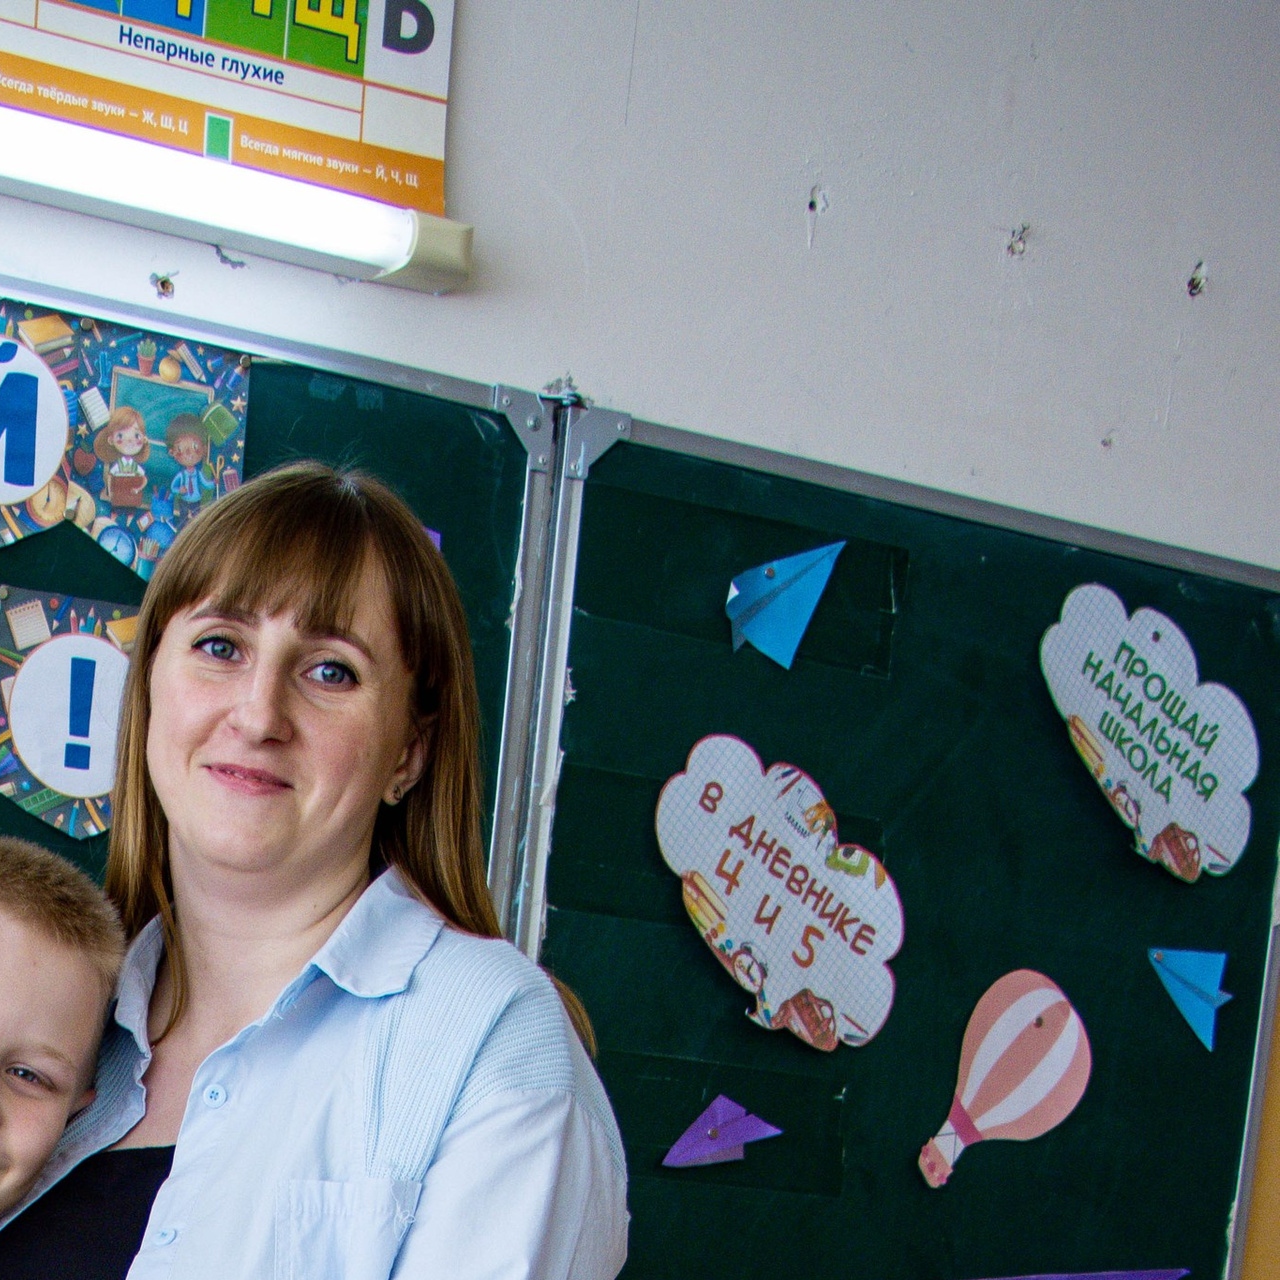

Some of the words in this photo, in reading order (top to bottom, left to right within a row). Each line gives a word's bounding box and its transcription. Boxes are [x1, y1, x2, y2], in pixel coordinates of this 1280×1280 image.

[119, 24, 215, 67] Непарные
[221, 51, 285, 85] глухие
[37, 84, 88, 109] твёрдые
[91, 100, 125, 118] звуки
[178, 119, 188, 135] Ц
[240, 134, 279, 157] Всегда
[282, 147, 323, 167] мягкие
[326, 158, 359, 175] звуки
[405, 173, 418, 189] Щ
[1081, 651, 1219, 802] НАЧАЛЬНАЯ
[1113, 641, 1219, 756] ПРОЩАЙ
[1098, 711, 1172, 804] ШКОЛА
[698, 782, 724, 814] В
[728, 815, 876, 956] ДНЕВНИКЕ
[791, 924, 825, 969] 5
